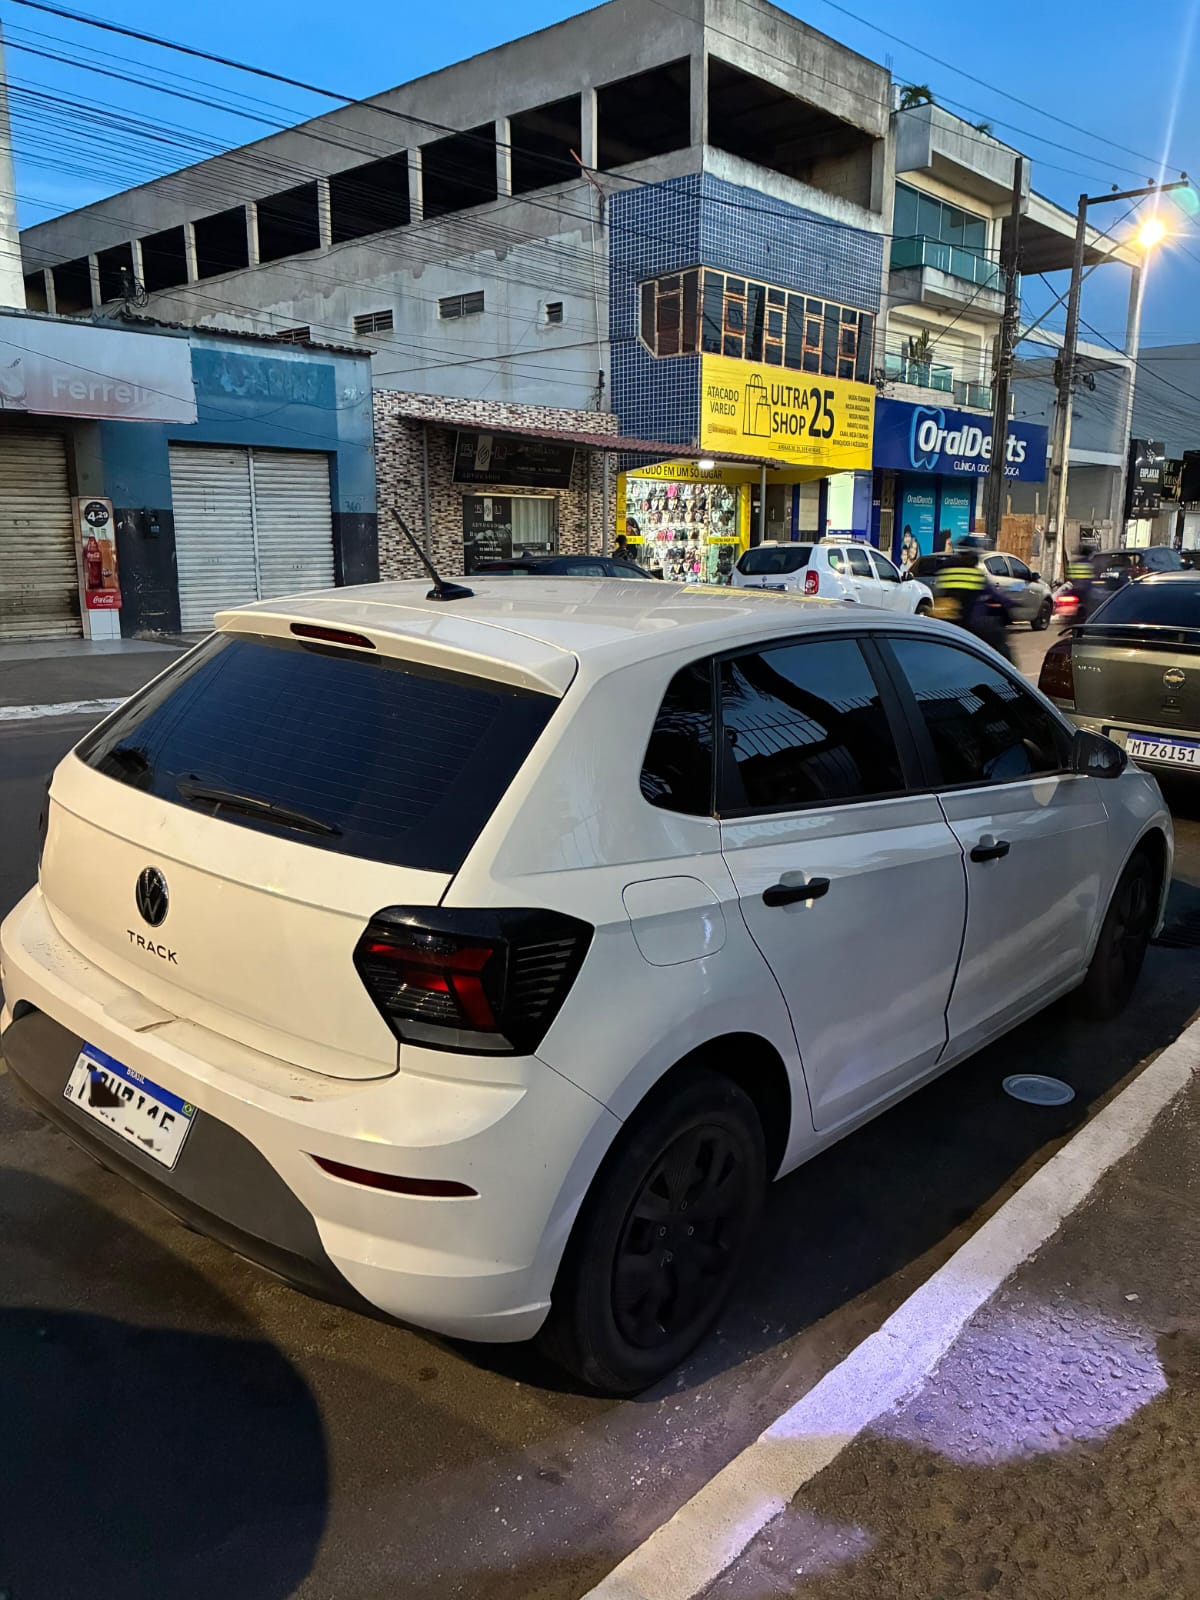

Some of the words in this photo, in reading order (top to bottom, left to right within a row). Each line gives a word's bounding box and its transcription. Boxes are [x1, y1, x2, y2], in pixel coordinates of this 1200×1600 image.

[707, 385, 739, 402] ATACADO
[771, 384, 809, 410] ULTRA
[710, 401, 736, 416] VAREJO
[808, 387, 835, 439] 25
[772, 412, 806, 436] SHOP
[918, 420, 1027, 463] OralDets
[663, 465, 675, 477] EM
[676, 466, 689, 478] UM
[700, 469, 723, 479] LUGAR
[953, 459, 976, 472] CLÍNICA
[127, 930, 178, 965] TRACK
[126, 1068, 145, 1084] BRASIL
